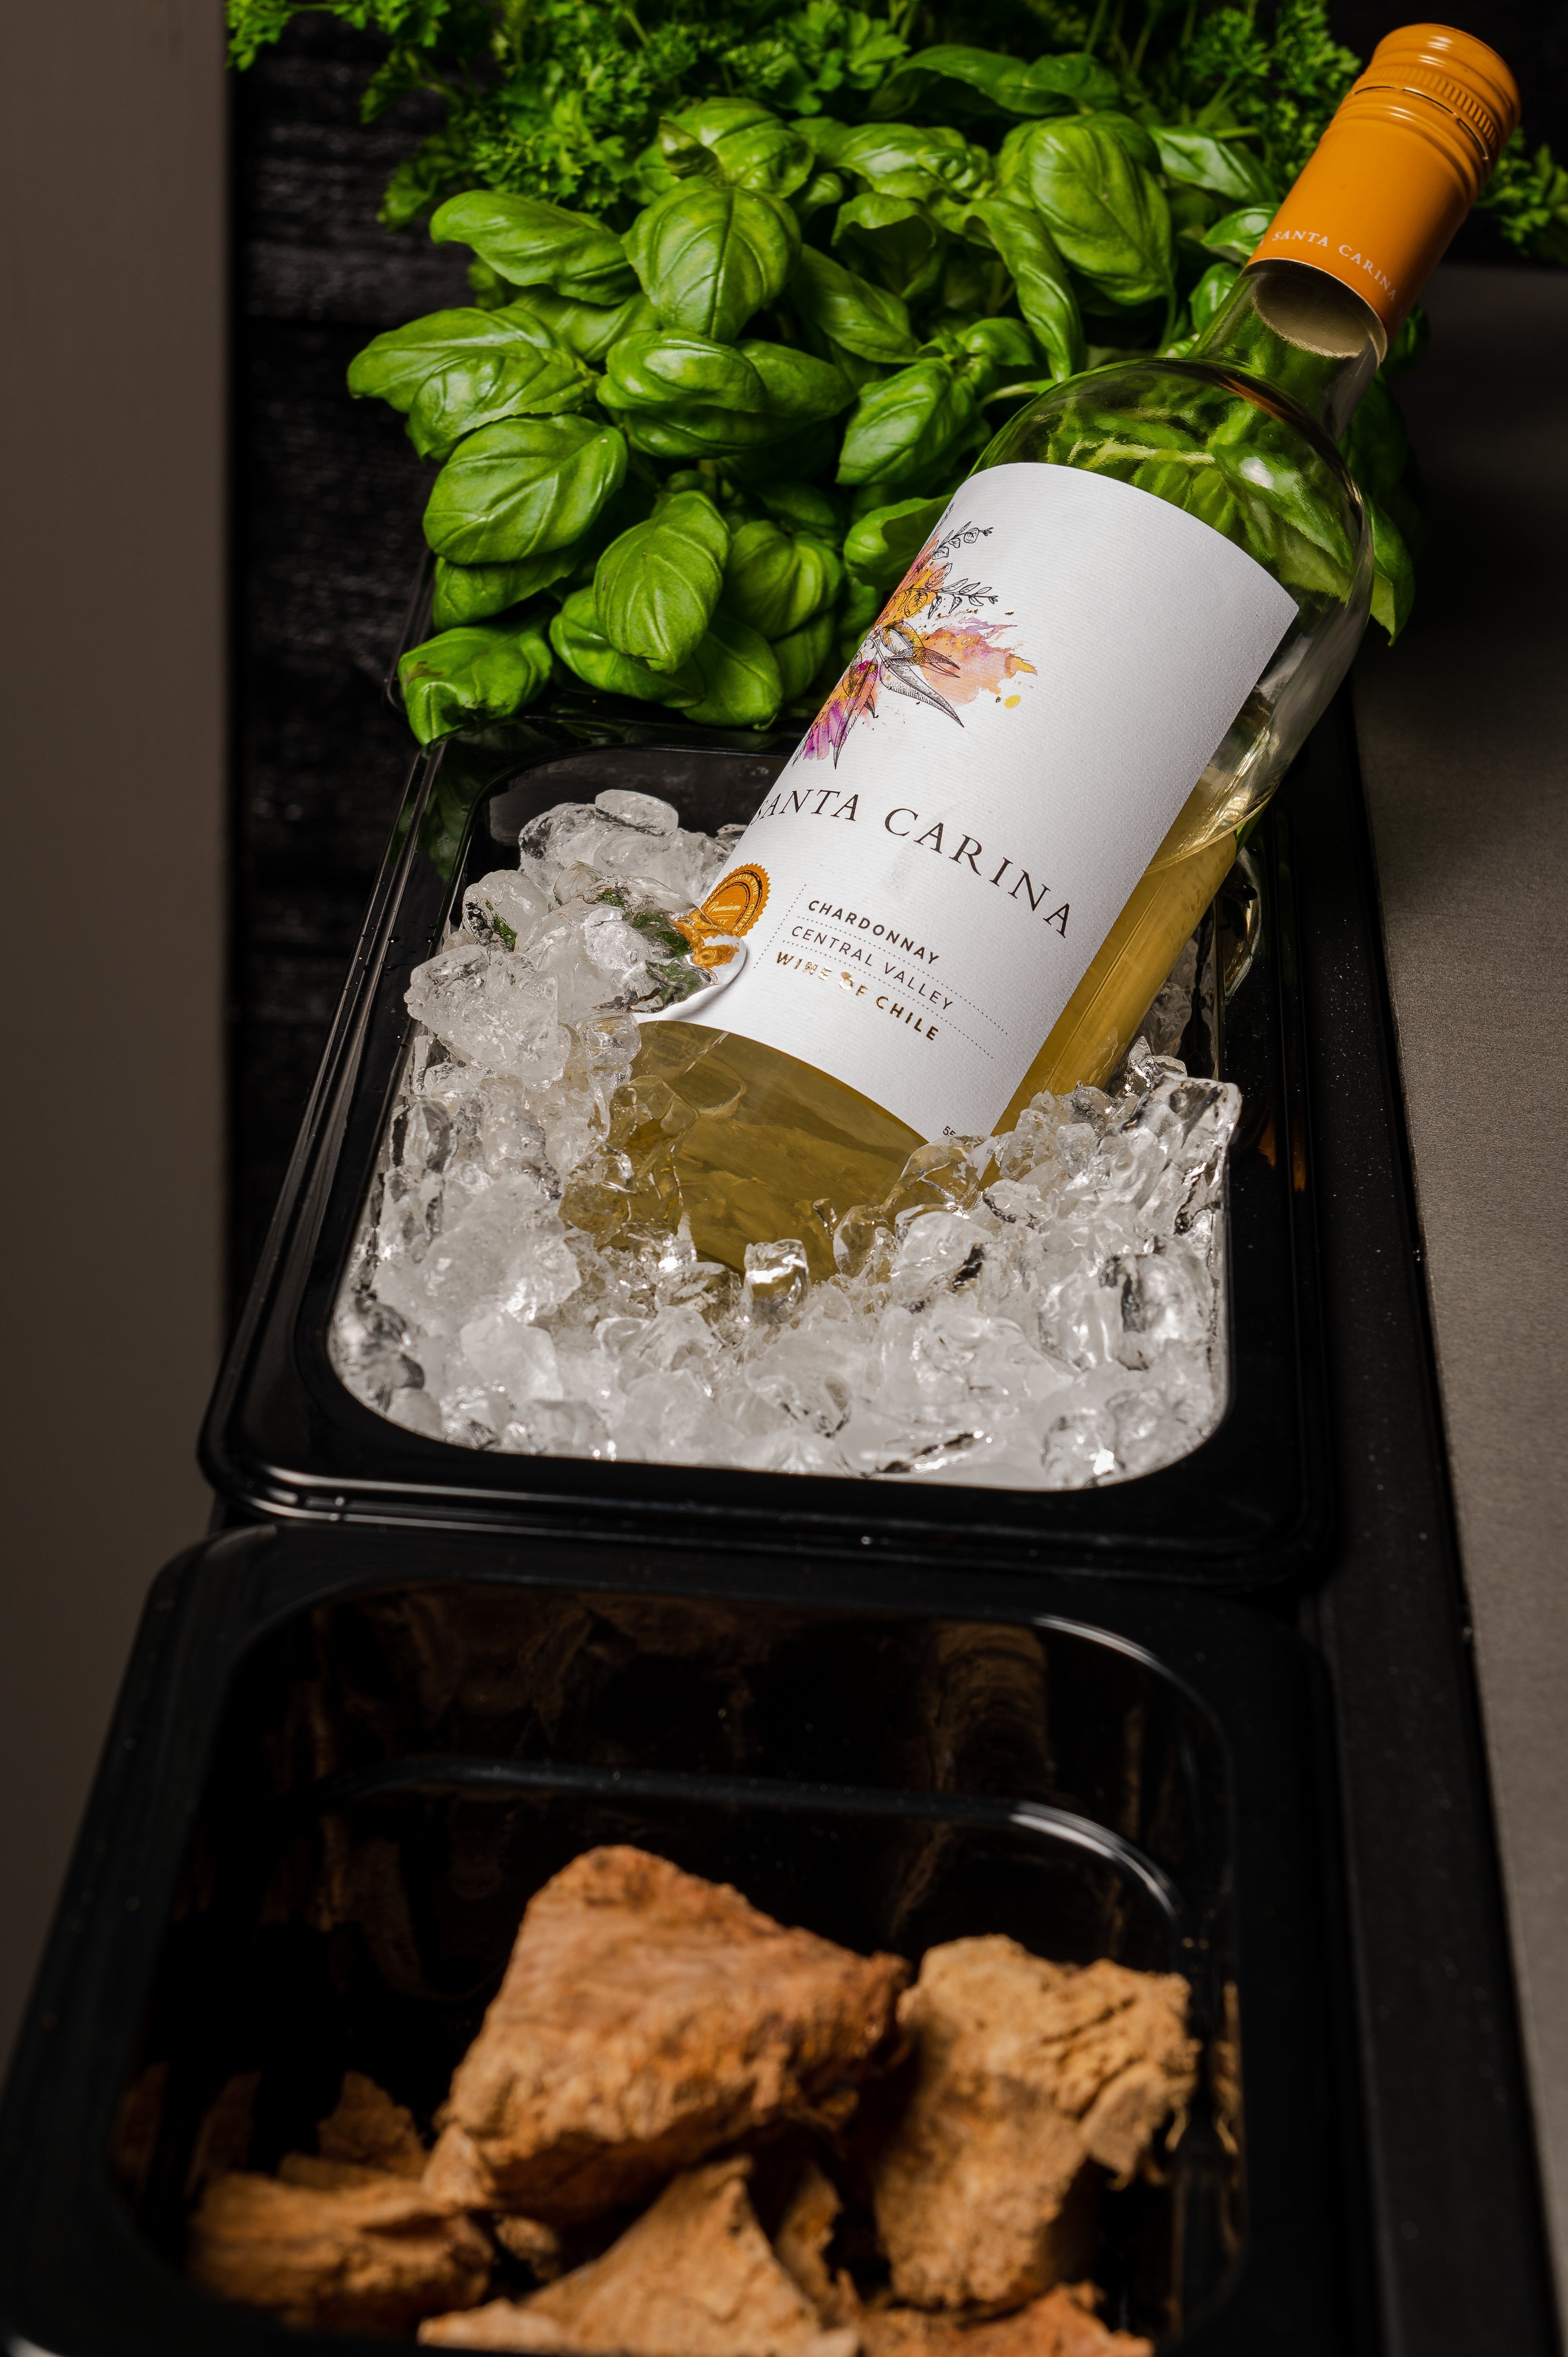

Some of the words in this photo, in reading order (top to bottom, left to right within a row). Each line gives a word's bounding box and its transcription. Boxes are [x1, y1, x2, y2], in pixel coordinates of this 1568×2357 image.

[1272, 230, 1329, 247] SANTA
[1338, 244, 1397, 301] CARINA
[750, 789, 859, 826] SANTA
[884, 808, 1070, 939] CARINA
[750, 879, 759, 896] WINE
[792, 926, 872, 966] CENTRAL
[885, 962, 953, 1010] VALLEY
[808, 900, 939, 964] CHARDONNAY
[776, 951, 832, 981] WINE
[839, 976, 869, 996] OF
[876, 996, 939, 1041] CHILE
